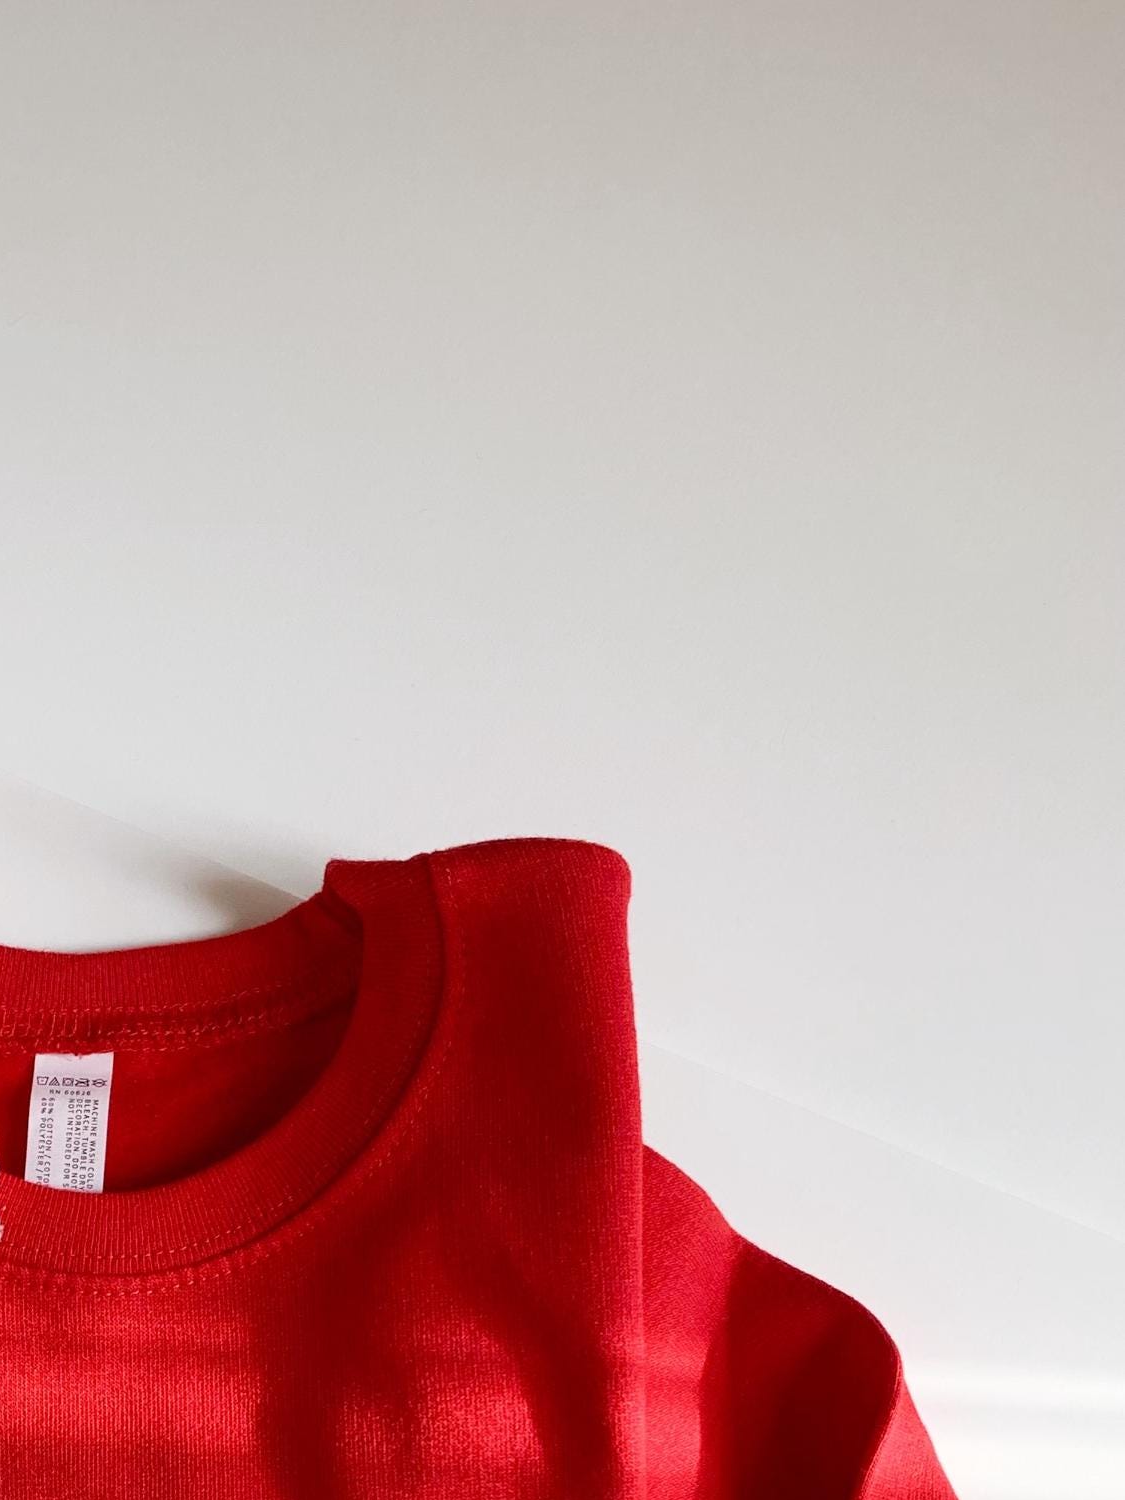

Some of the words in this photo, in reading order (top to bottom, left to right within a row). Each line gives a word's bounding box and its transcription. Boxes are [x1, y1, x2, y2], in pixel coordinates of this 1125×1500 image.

[68, 1098, 76, 1114] NOT
[89, 1099, 100, 1137] MACHINE
[37, 1117, 46, 1166] POLYESTER
[45, 1117, 54, 1151] COTTON
[64, 1117, 74, 1160] INTENDED
[71, 1158, 79, 1169] DO
[79, 1137, 89, 1171] TUMBLE
[88, 1140, 97, 1164] WASH
[63, 1163, 71, 1179] FOR
[70, 1172, 78, 1189] NOT
[78, 1174, 86, 1191] DRY
[86, 1167, 95, 1190] COLD
